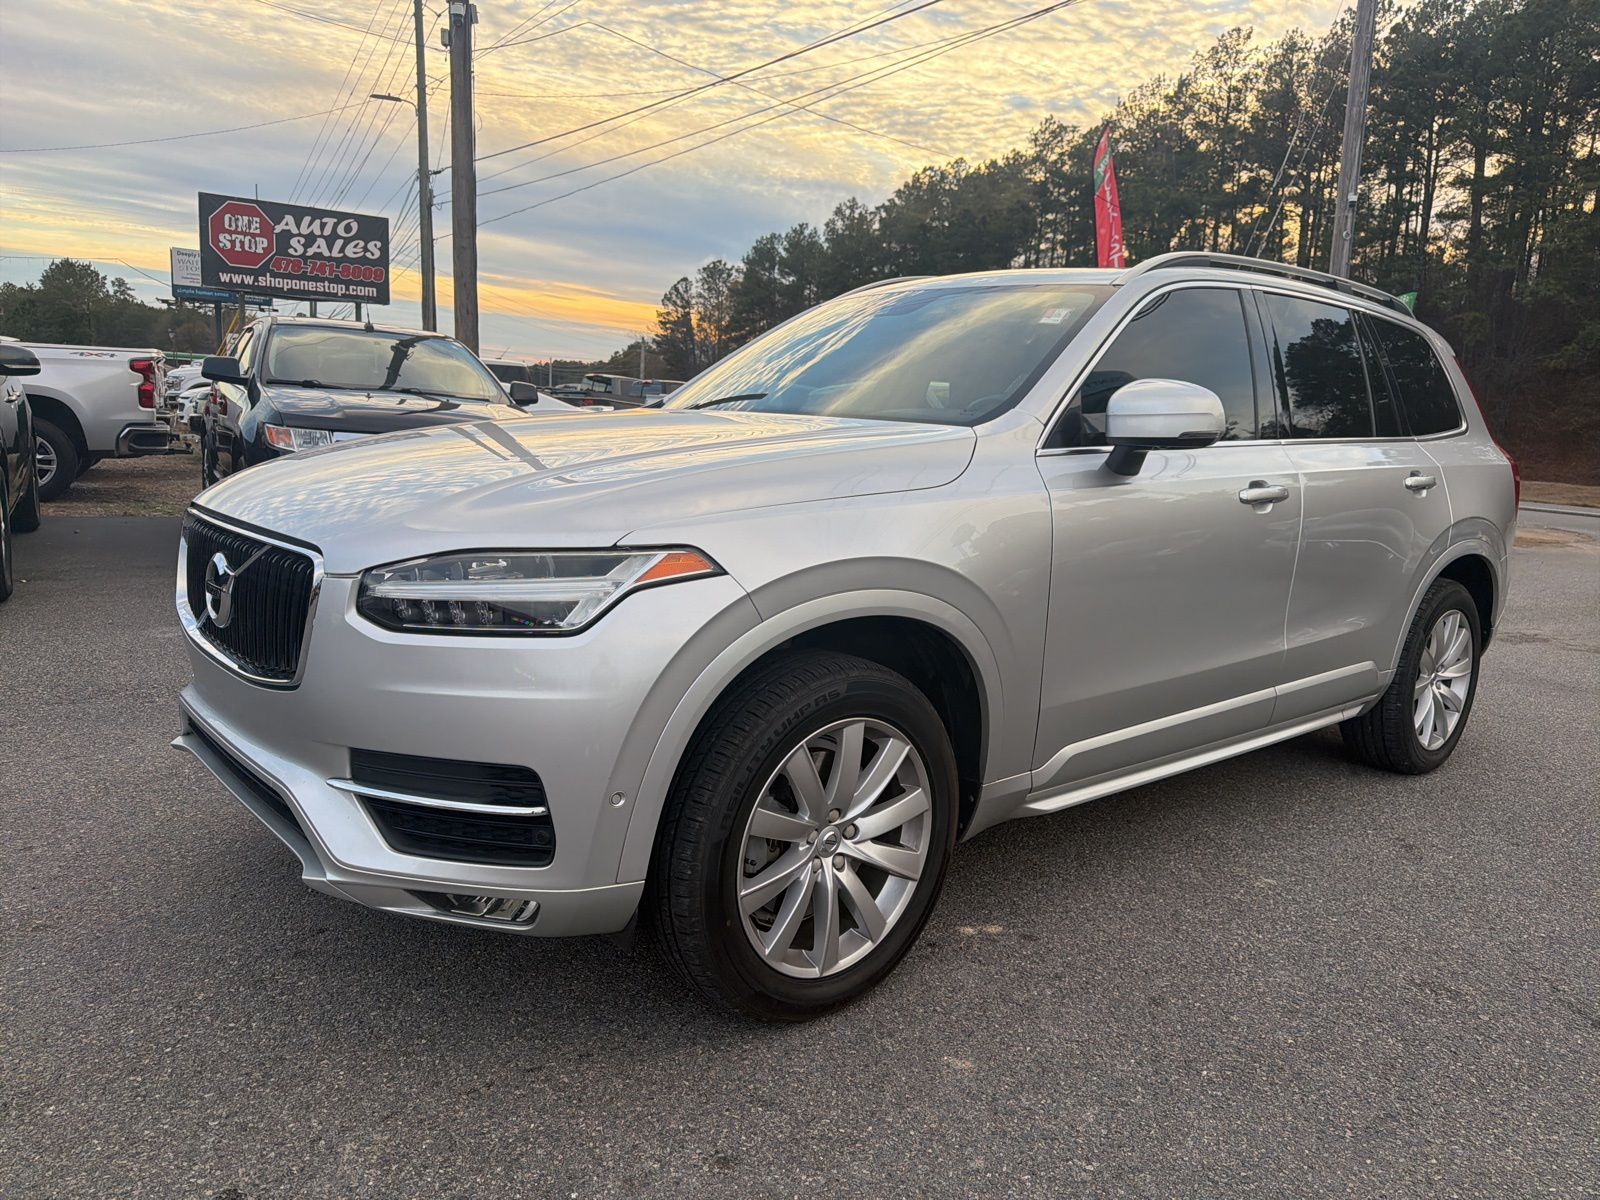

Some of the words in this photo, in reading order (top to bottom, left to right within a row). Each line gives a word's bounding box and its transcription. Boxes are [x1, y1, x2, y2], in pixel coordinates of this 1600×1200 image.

[224, 213, 261, 234] ONE
[273, 215, 359, 236] AUTO
[218, 233, 268, 254] STOP
[219, 272, 377, 297] www.shoponestop.com
